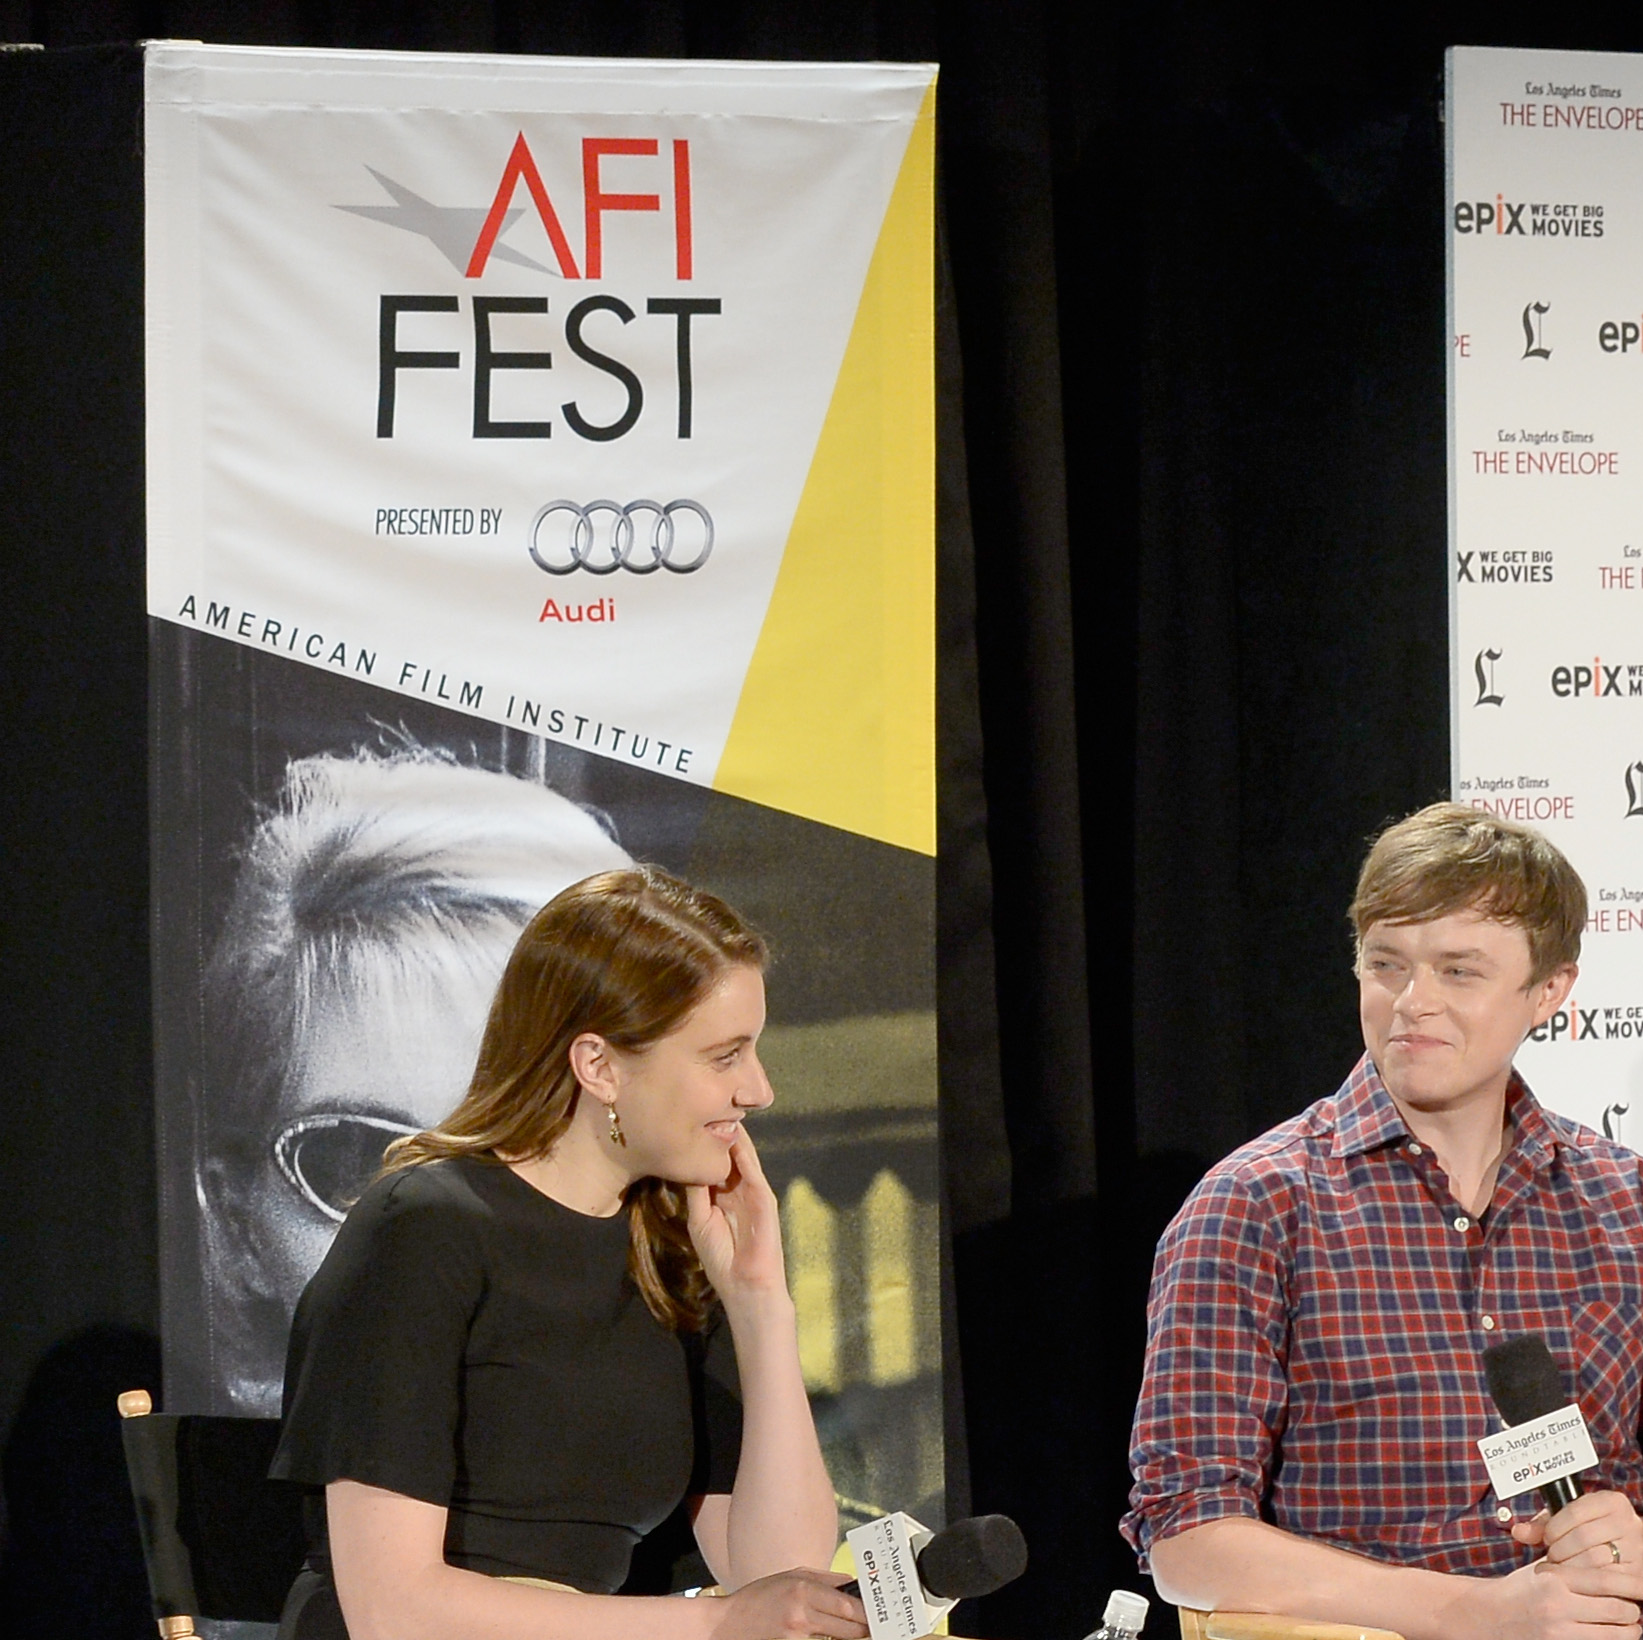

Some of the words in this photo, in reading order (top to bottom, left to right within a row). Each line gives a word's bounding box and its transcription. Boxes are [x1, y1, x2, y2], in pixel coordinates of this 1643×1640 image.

[1524, 81, 1545, 96] Los
[1545, 81, 1587, 100] Angeles
[1588, 83, 1622, 99] Times
[1499, 102, 1537, 128] THE
[464, 129, 692, 281] AFI
[1531, 218, 1604, 238] MOVIES
[375, 295, 722, 442] FEST
[375, 509, 475, 536] PRESENTED
[480, 509, 502, 536] BY
[1478, 550, 1499, 564] WE
[1502, 550, 1528, 564] GET
[1531, 550, 1554, 564] BIG
[1480, 564, 1554, 584] MOVIES
[1597, 566, 1635, 590] THE
[539, 598, 616, 624] Audi
[178, 595, 377, 676] AMERICAN
[399, 662, 483, 710] FILM
[506, 695, 694, 775] INSTITUTE
[1603, 1007, 1623, 1020] WE
[1484, 1446, 1504, 1459] Los
[1507, 1430, 1546, 1452] Angeles
[1547, 1416, 1581, 1435] Times
[1544, 1456, 1575, 1471] MOVIES
[884, 1520, 893, 1543] Los
[889, 1546, 908, 1593] Angeles
[902, 1594, 917, 1635] Times
